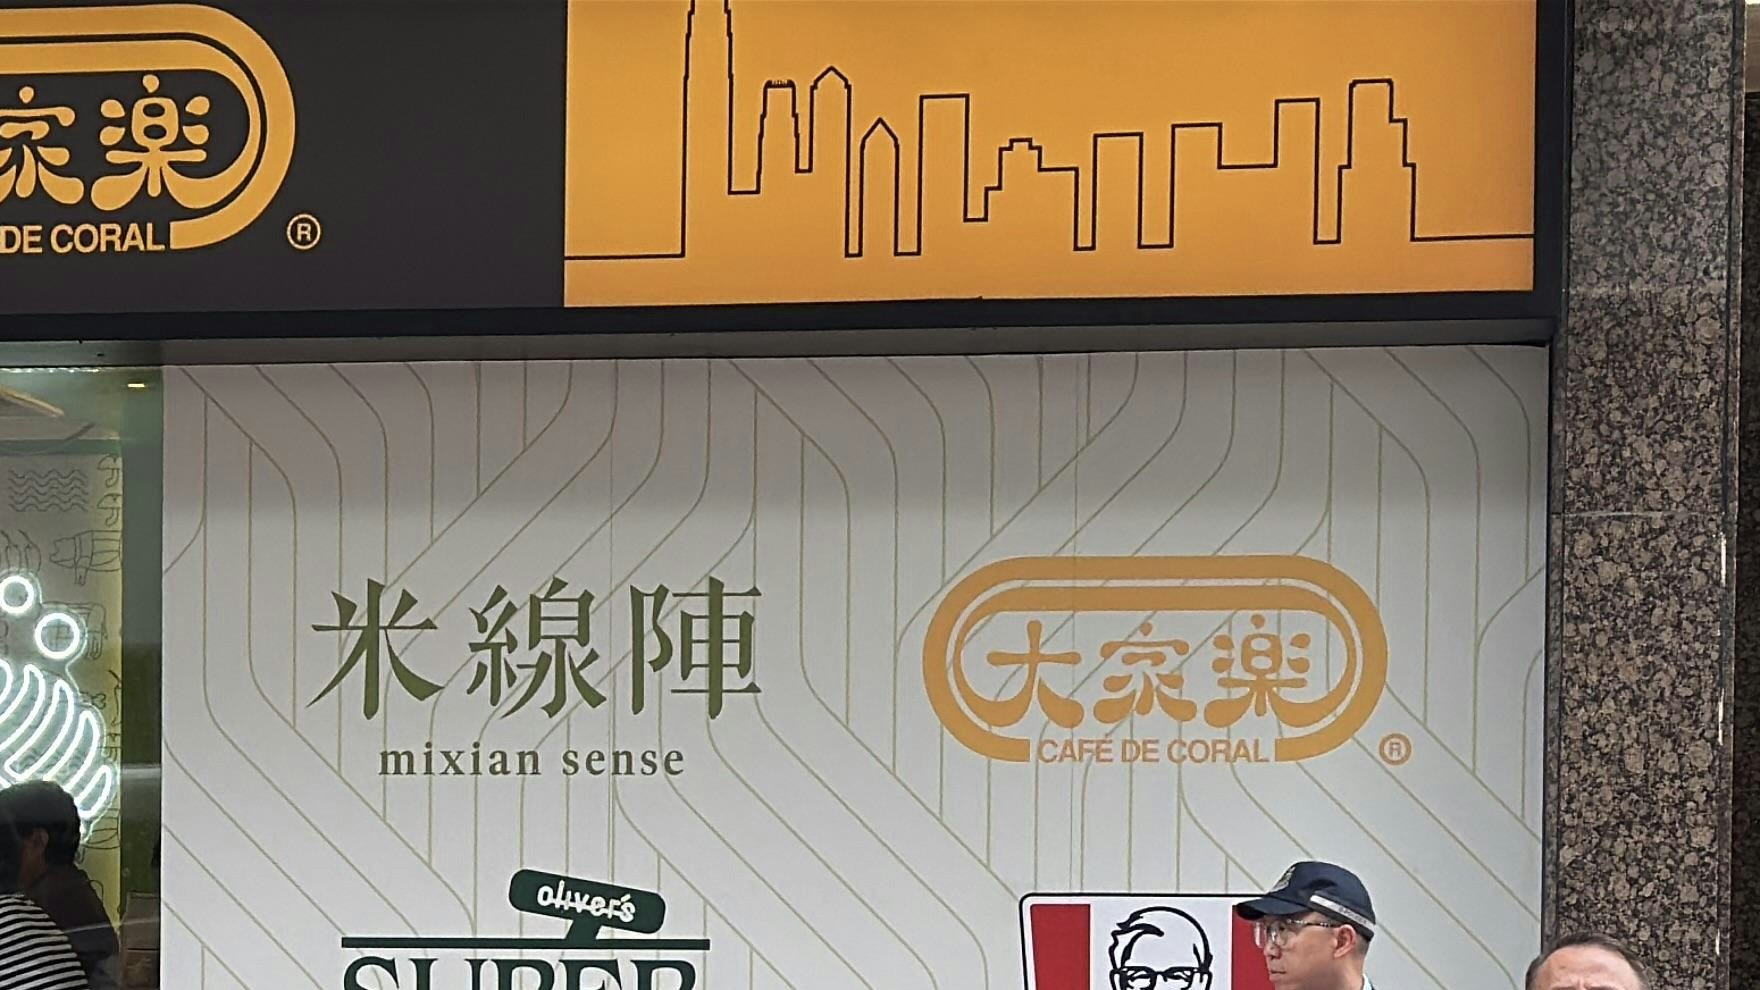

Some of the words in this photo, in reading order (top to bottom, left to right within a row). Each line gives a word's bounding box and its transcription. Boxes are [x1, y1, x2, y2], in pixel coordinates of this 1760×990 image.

[0, 225, 42, 253] DE
[50, 222, 166, 253] CORAL
[306, 575, 762, 720] 米線陣
[378, 741, 542, 776] mixian
[561, 746, 685, 776] sense
[1037, 732, 1113, 764] CAFÉ
[1121, 738, 1159, 763] DE
[1167, 738, 1269, 763] CORAL
